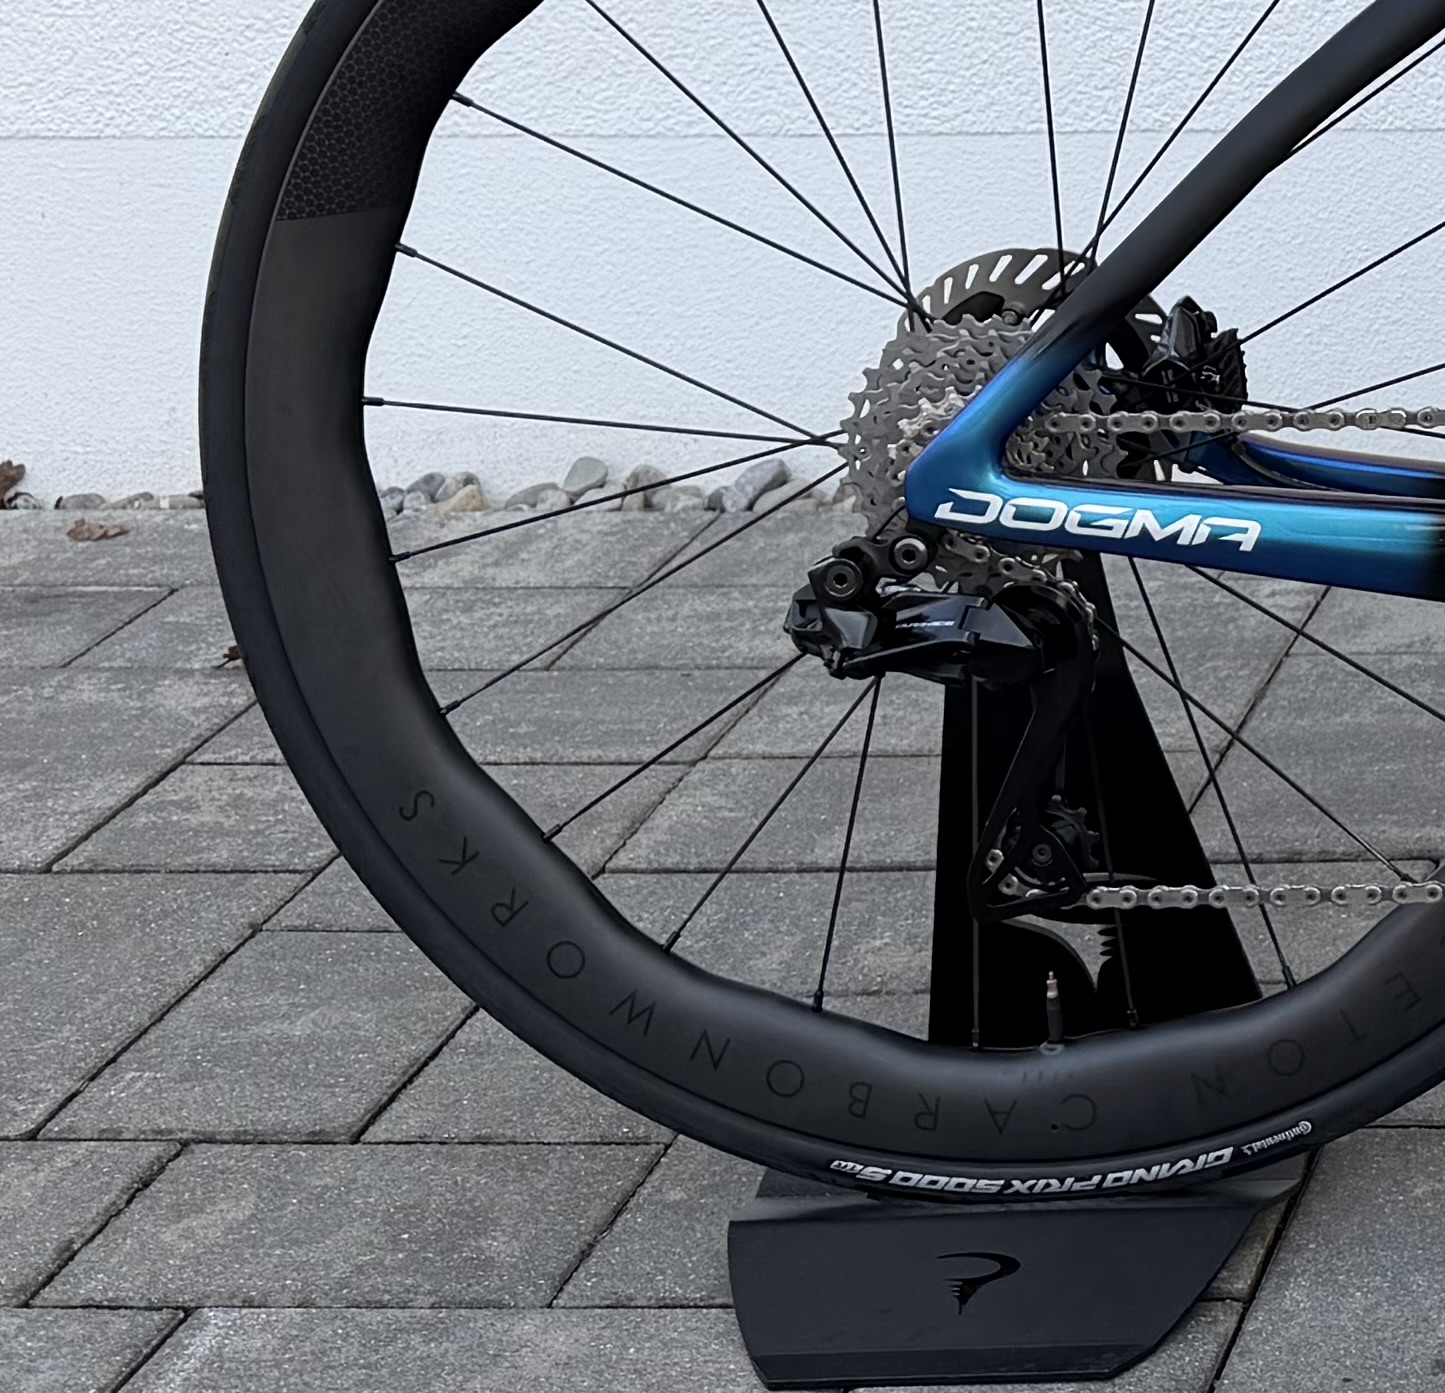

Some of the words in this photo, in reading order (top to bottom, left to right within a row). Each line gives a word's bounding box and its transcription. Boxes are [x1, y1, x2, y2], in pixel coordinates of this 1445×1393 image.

[933, 486, 1263, 554] DOGMA
[887, 1169, 1003, 1194] 5000
[1101, 1145, 1235, 1189] GRAND
[1006, 1174, 1102, 1195] PRIX
